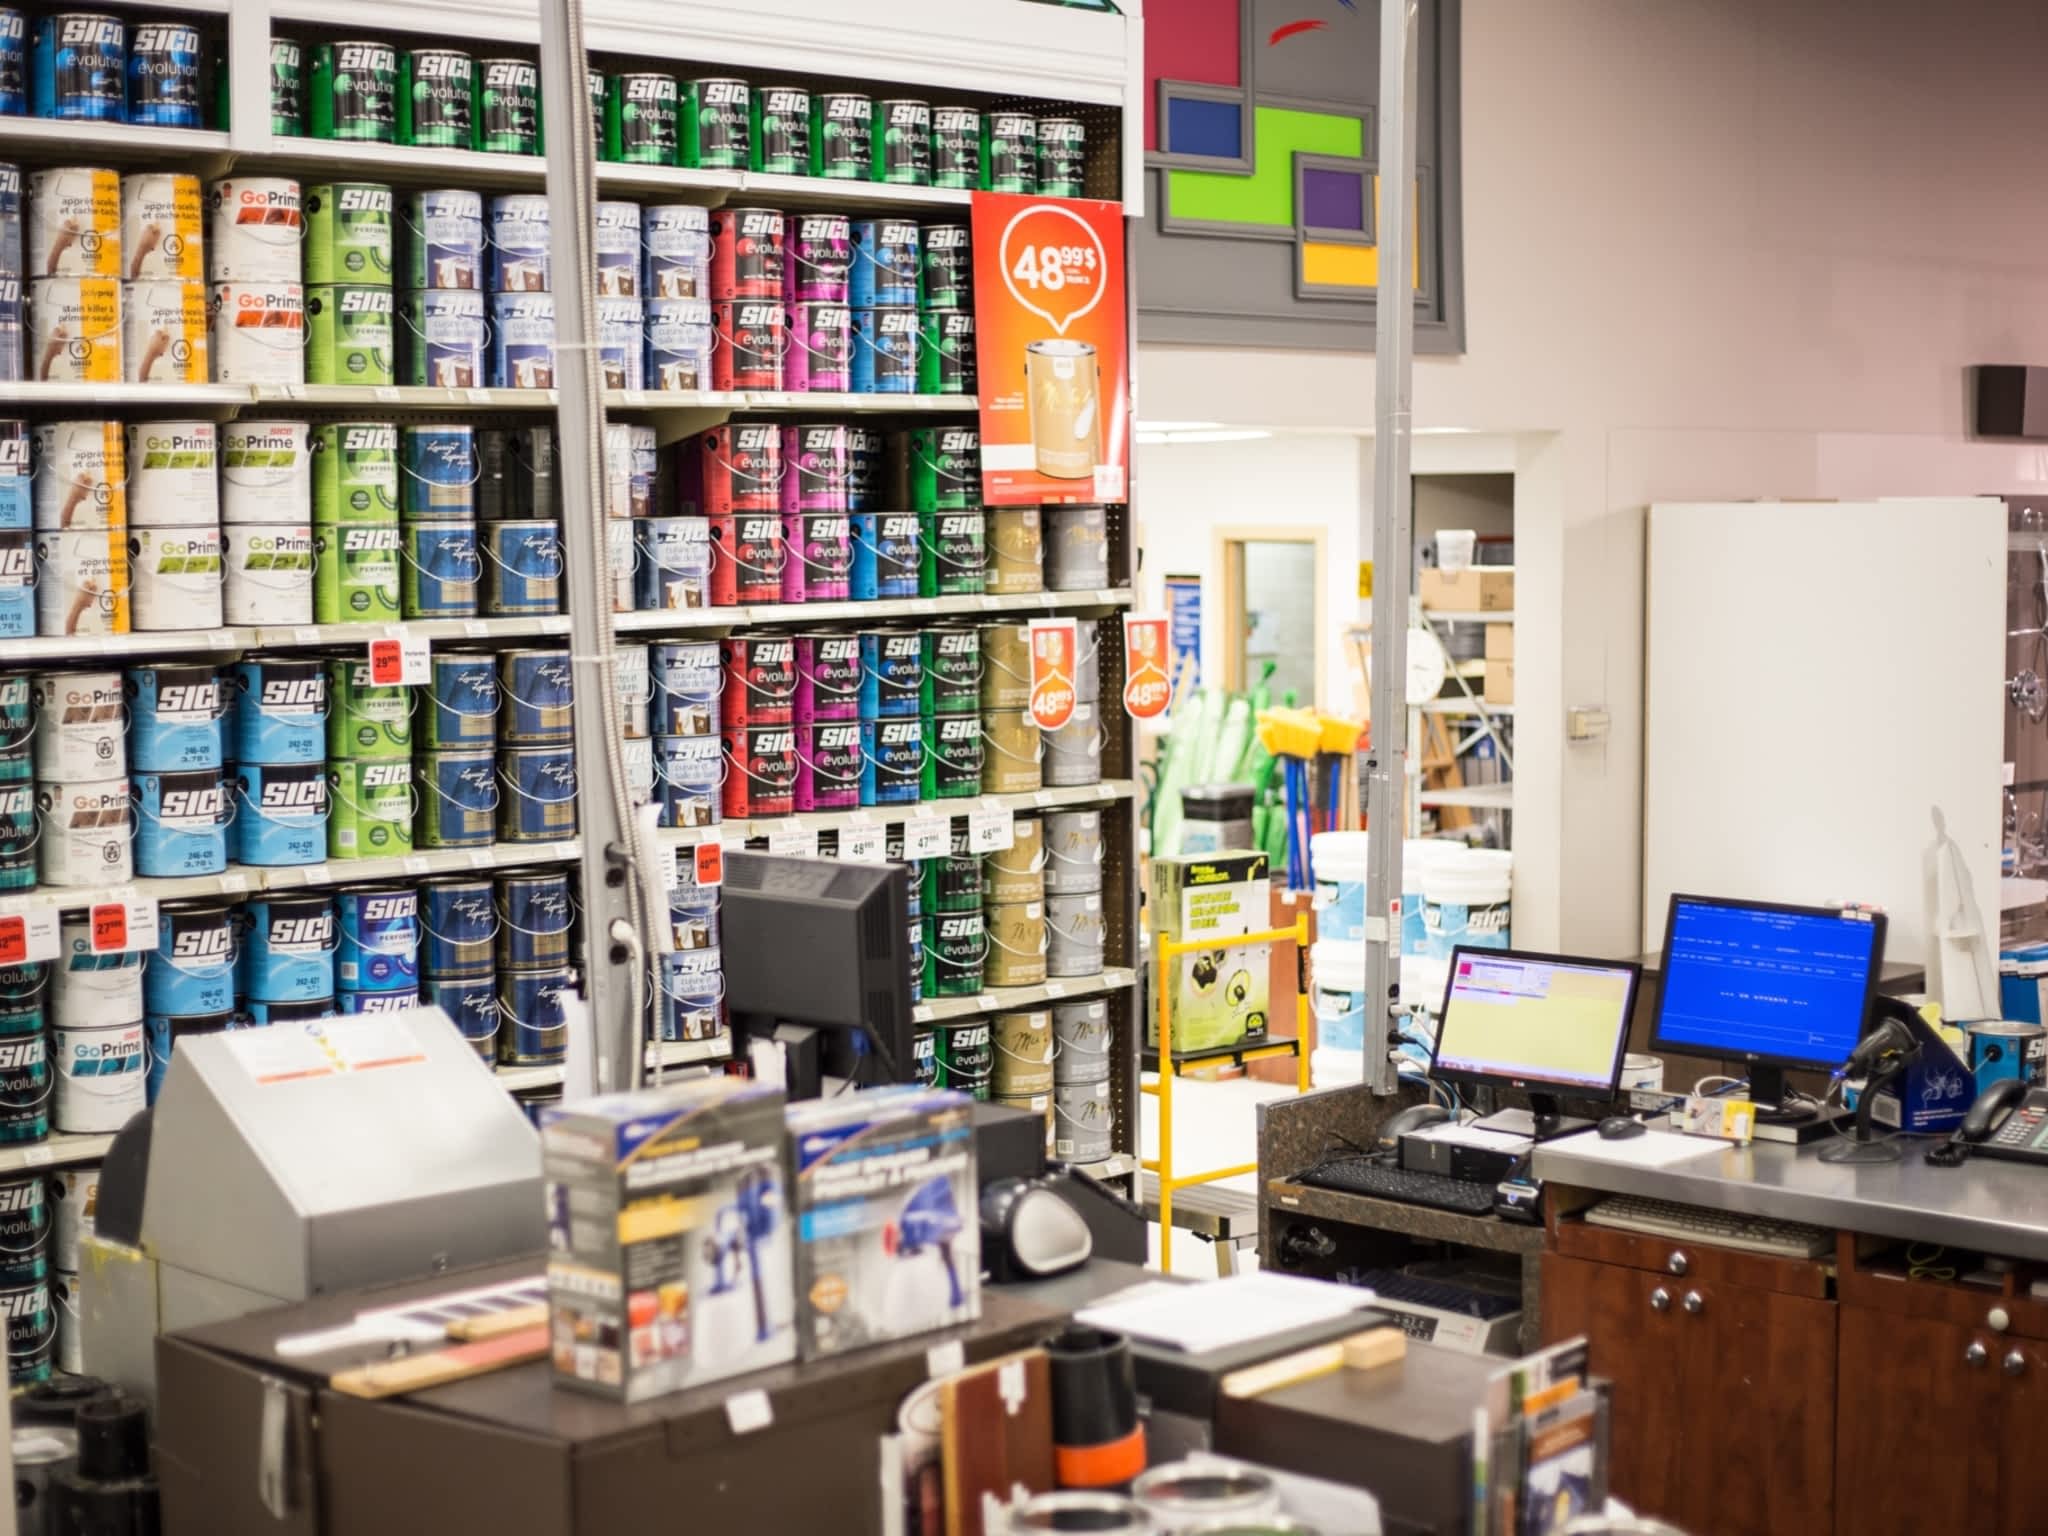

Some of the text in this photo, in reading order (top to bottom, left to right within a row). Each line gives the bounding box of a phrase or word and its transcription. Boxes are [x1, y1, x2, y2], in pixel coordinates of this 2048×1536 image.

[62, 19, 124, 46] SICO
[133, 28, 199, 54] SICO
[138, 60, 199, 77] evolution
[239, 190, 300, 207] GoPrim
[742, 214, 784, 236] SIC
[880, 226, 918, 246] SIC
[927, 229, 969, 249] SIC
[739, 307, 784, 326] SIC
[814, 309, 853, 328] SIC
[880, 314, 919, 333] SIC
[226, 434, 294, 451] GoPrime
[737, 430, 781, 449] SIC
[805, 430, 849, 449] SIC
[941, 432, 978, 451] SIC
[742, 519, 783, 539] SIC
[811, 519, 849, 539] SIC
[883, 518, 919, 537] SIC
[753, 642, 794, 664] SIC
[821, 640, 860, 660] SIC
[885, 637, 921, 657] SIC
[939, 634, 979, 654] SIC
[819, 728, 860, 748] SIC
[882, 723, 921, 744] SIC
[941, 719, 981, 740] SIC
[754, 732, 794, 753] SIC
[952, 1026, 989, 1049] SIC
[75, 1040, 141, 1058] GoPrime
